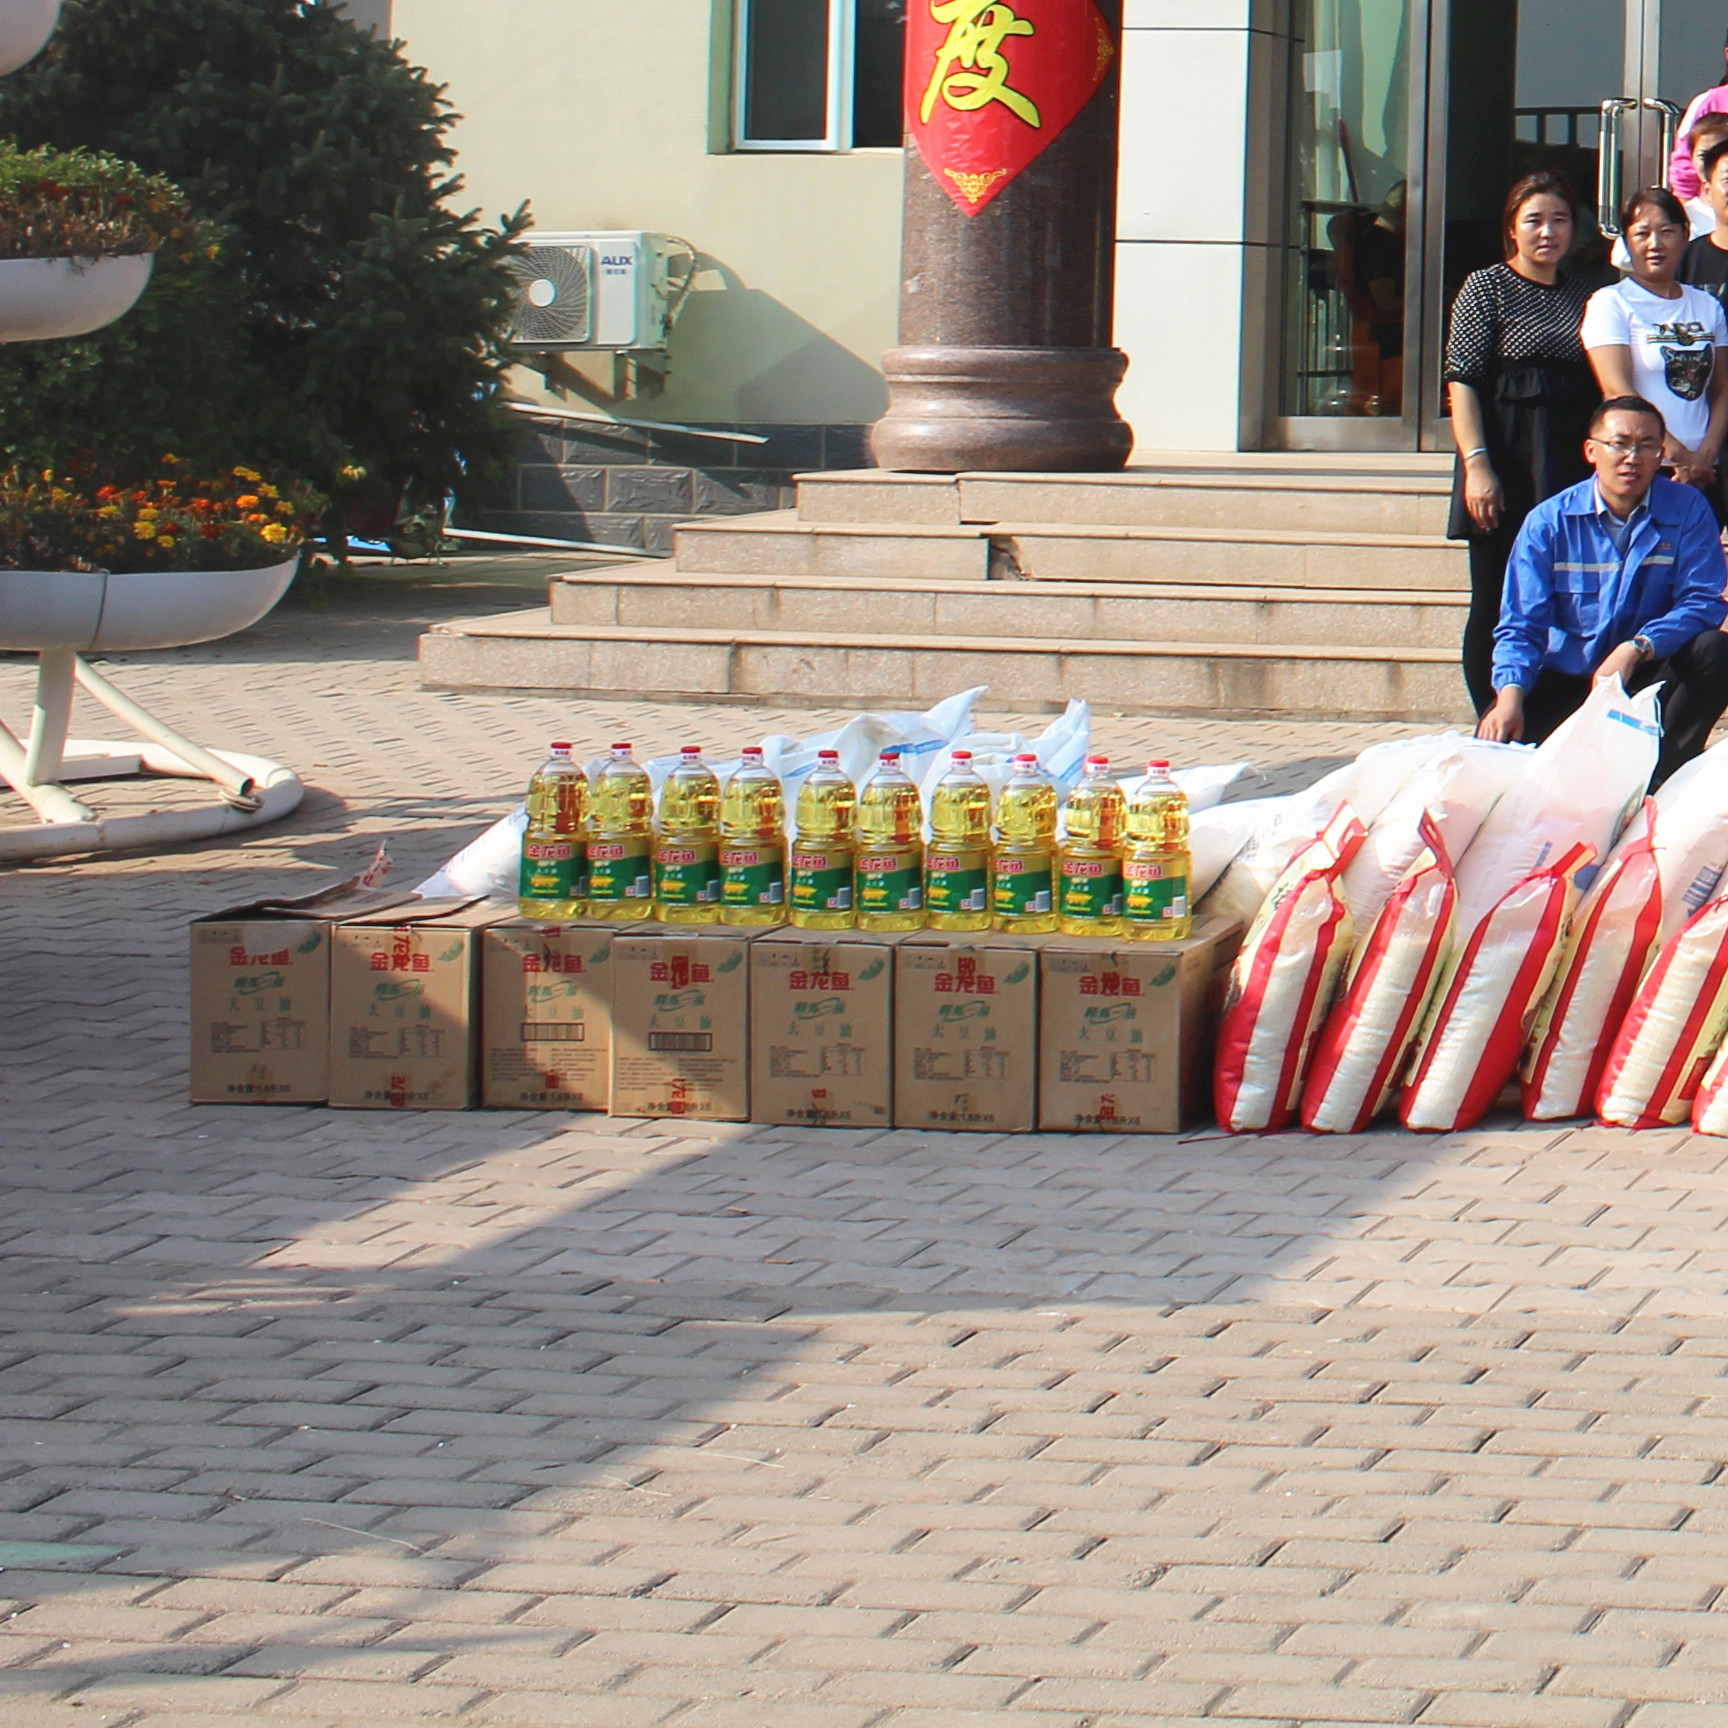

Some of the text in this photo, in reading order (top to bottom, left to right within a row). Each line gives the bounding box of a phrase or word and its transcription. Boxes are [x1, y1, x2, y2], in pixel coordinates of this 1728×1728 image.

[601, 256, 632, 266] AUX
[529, 845, 571, 859] 金龙鱼
[657, 849, 695, 863] 金龙鱼
[1063, 859, 1103, 875] 金龙鱼
[523, 954, 583, 973] 金龙鱼
[789, 971, 851, 991] 金龙鱼
